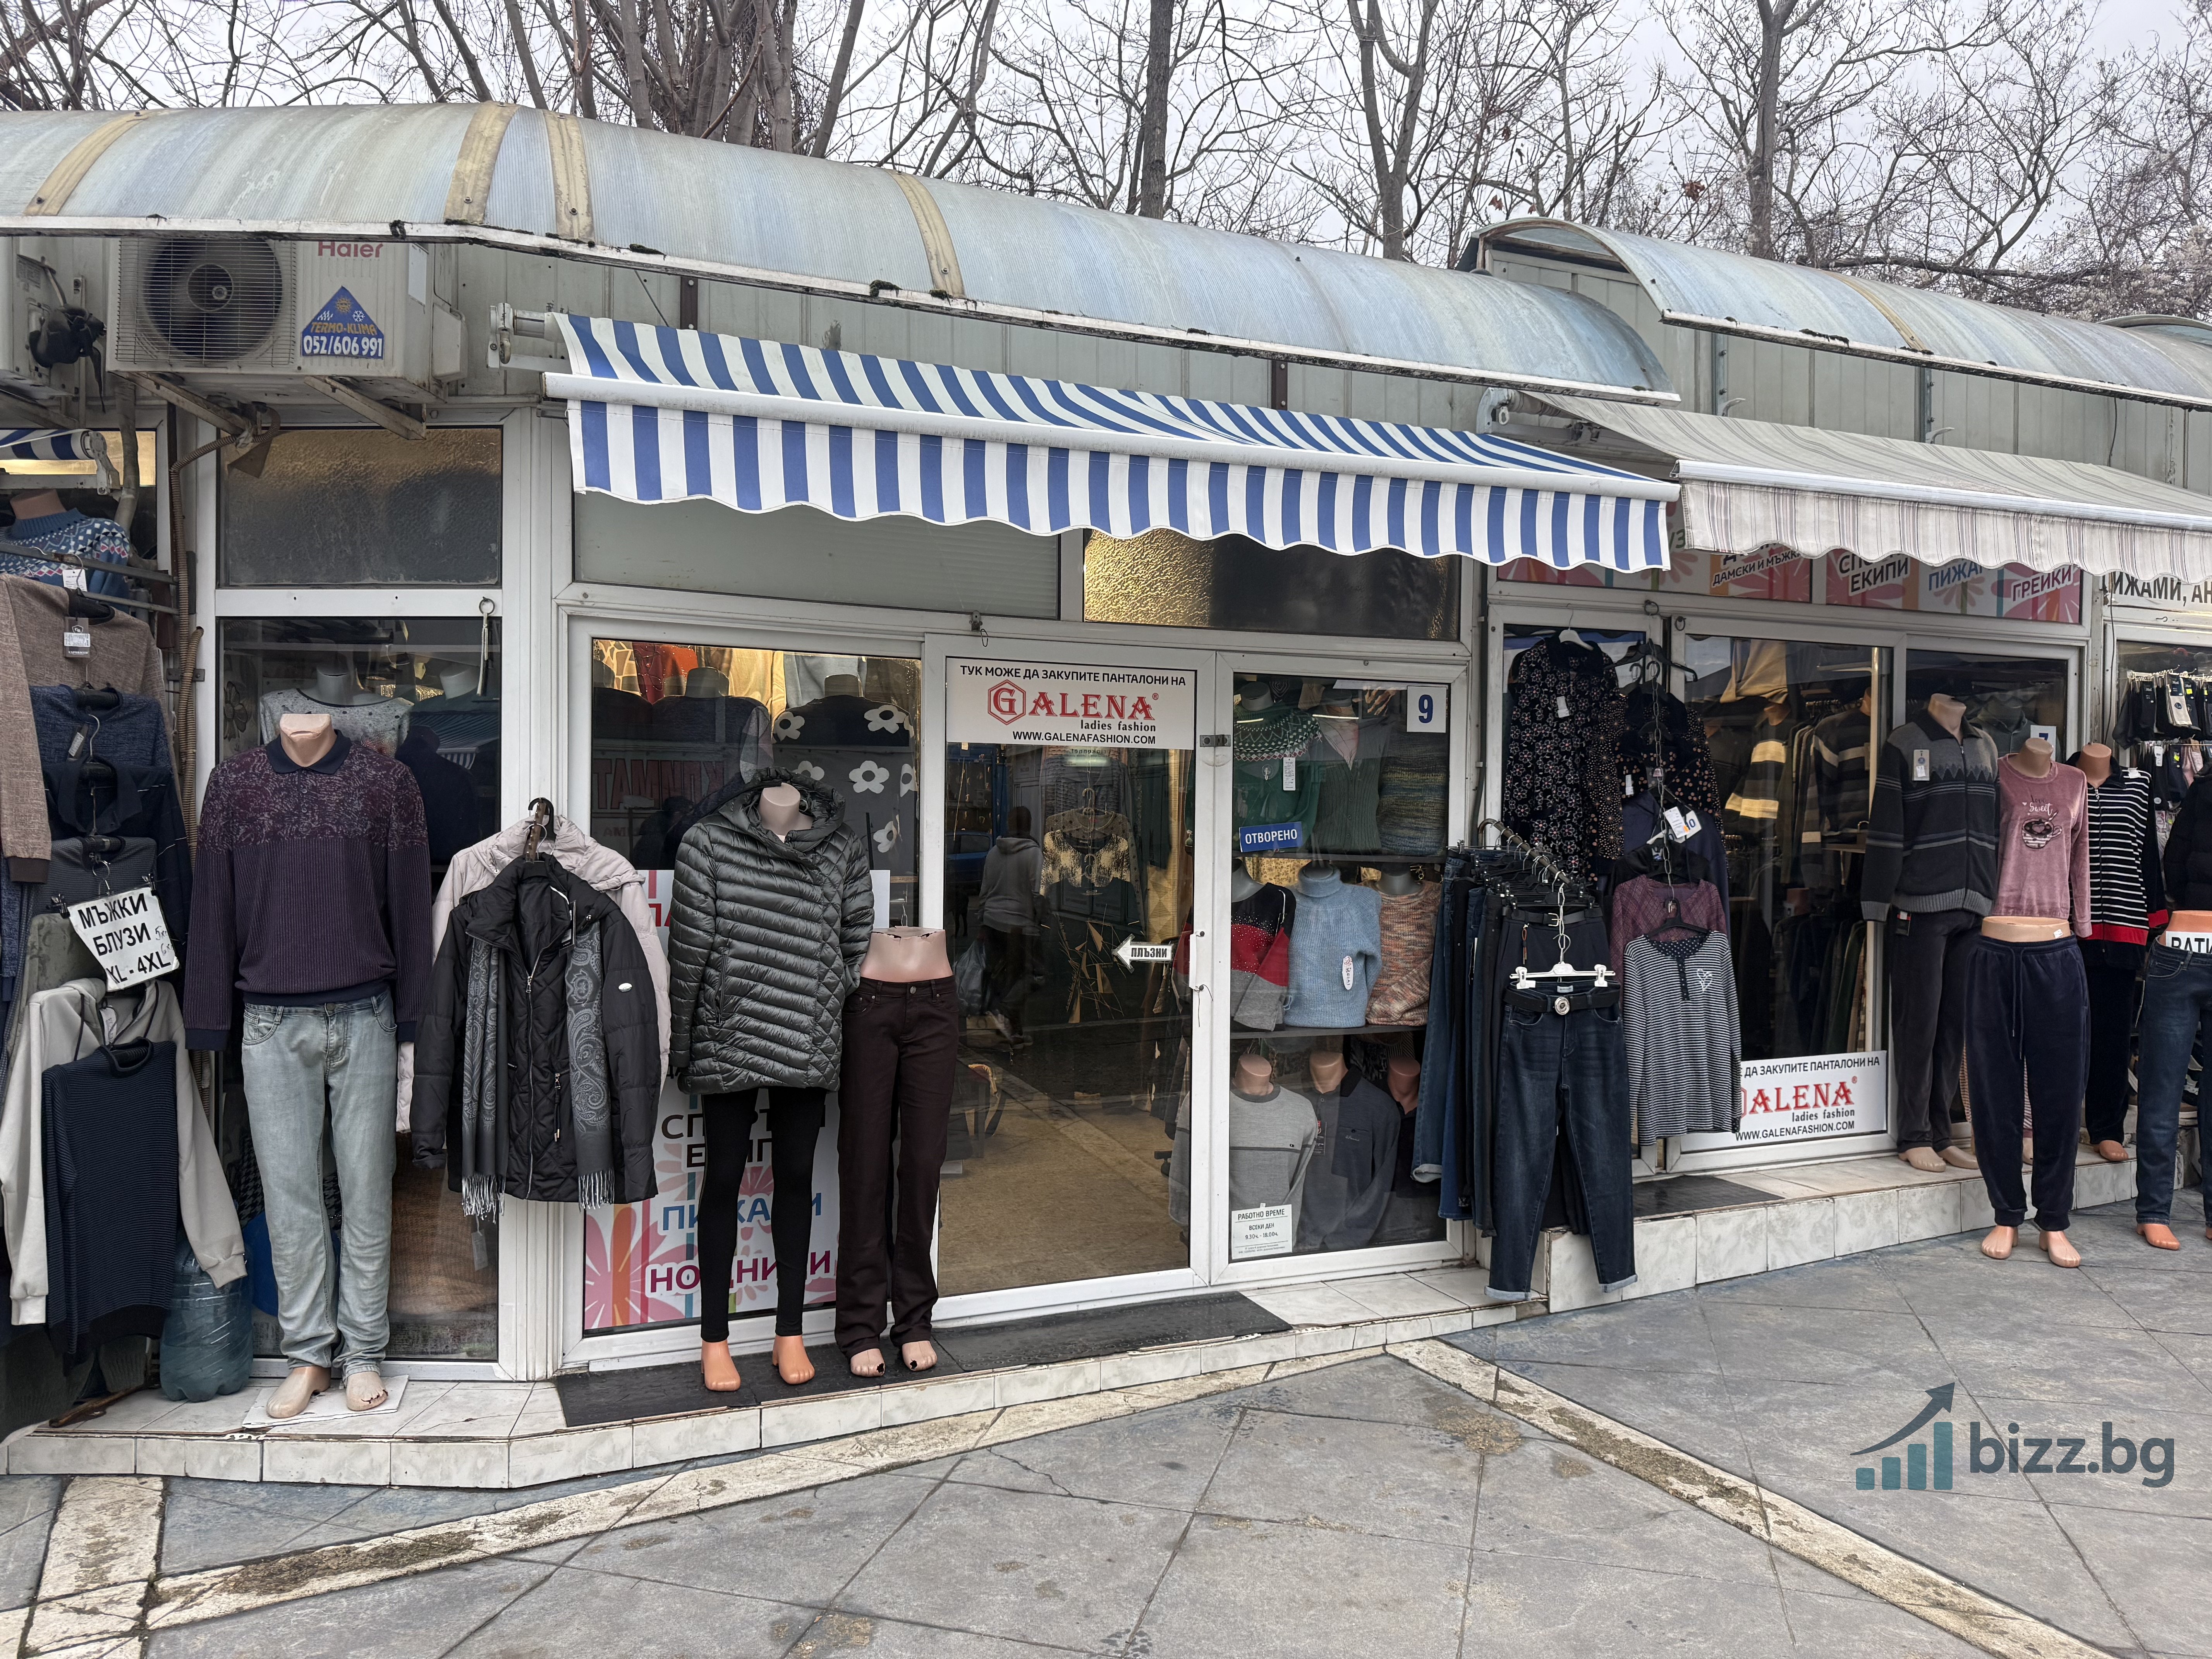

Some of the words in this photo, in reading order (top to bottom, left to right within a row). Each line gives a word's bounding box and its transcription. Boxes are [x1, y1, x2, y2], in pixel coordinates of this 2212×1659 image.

[318, 242, 383, 258] Haier
[311, 322, 377, 335] TERMO-KLIMA
[1713, 563, 1755, 586] ДАМСКИ
[1767, 549, 1802, 566] МЪЖК
[1851, 558, 1908, 592] ЕКИПИ
[960, 665, 982, 675] ТУК
[985, 666, 1021, 678] МОЖЕ
[1023, 669, 1039, 680] ДА
[1042, 670, 1100, 682] ЗАКУПИТЕ
[1103, 673, 1168, 685] ПАНТАЛОНИ
[1171, 677, 1186, 686] НА
[1419, 694, 1433, 723] 9
[1081, 720, 1112, 730] ladies
[1118, 721, 1156, 732] fashion
[1013, 731, 1156, 744] WWW.GALENAFASHION.COM
[2029, 802, 2053, 816] Sweet
[1245, 829, 1298, 845] ОТВОРЕНО
[78, 893, 148, 929] МЪЖКИ
[93, 922, 151, 956] БЛУЗИ
[137, 951, 171, 974] 4XL
[1131, 948, 1167, 958] ПЛЪЗНИ
[1744, 1067, 1758, 1078] ДА
[1760, 1062, 1808, 1075] ЗАКУПИТЕ
[1810, 1058, 1865, 1071] ПАНТАЛОНИ
[1868, 1056, 1880, 1066] НА
[1749, 1081, 1855, 1115] ALENA
[1792, 1111, 1818, 1122] ladies
[1823, 1108, 1855, 1120] fashion
[1735, 1121, 1855, 1141] WWW.GALENAFASHION.COM
[1238, 1211, 1264, 1220] РАБОТНО
[1266, 1209, 1285, 1217] ВРЕМЕ
